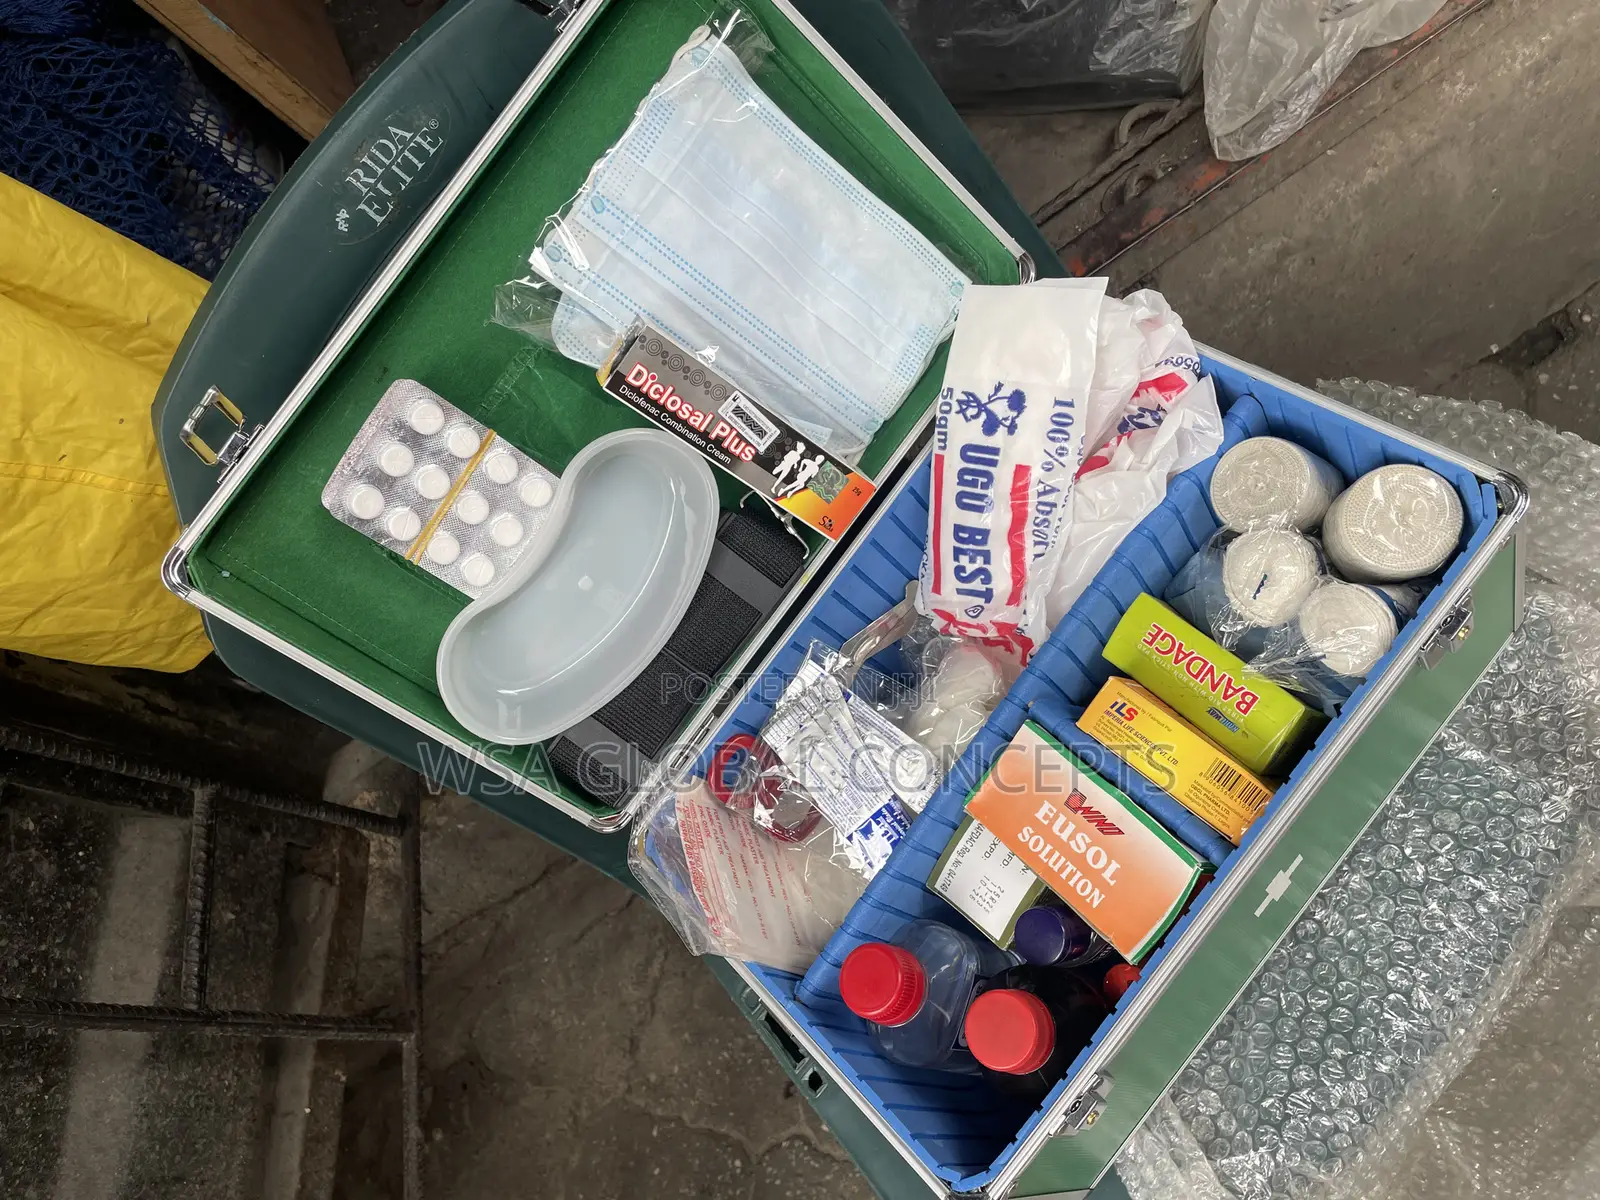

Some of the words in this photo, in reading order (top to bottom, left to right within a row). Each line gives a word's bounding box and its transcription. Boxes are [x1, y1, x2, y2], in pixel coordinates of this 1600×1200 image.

[345, 126, 414, 196] RIDA
[618, 383, 661, 417] Diclofenac
[659, 411, 707, 448] Combination
[705, 442, 732, 465] Cream
[625, 361, 714, 433] Diclosal
[707, 418, 761, 465] Plus
[933, 386, 954, 451] 50gm
[1041, 395, 1075, 473] 100%
[951, 524, 1000, 604] BEST
[1136, 642, 1150, 655] PAD
[1141, 622, 1260, 717] BANDAGE
[1188, 680, 1207, 696] WITH
[1207, 694, 1221, 706] AID
[1102, 708, 1124, 726] IMPERIA
[1124, 723, 1134, 733] LIFE
[1132, 730, 1157, 750] SCIENCES
[1155, 746, 1168, 758] PVT.
[1221, 704, 1244, 723] FIRST
[1202, 792, 1221, 808] PHARMA
[1204, 776, 1228, 795] 906056
[1228, 794, 1254, 814] 841005
[711, 828, 724, 856] PLASTER
[746, 837, 759, 865] PLASTER
[1034, 800, 1123, 886] EUSOL
[725, 851, 740, 890] TREATMENT
[760, 860, 776, 899] TREATMENT
[1016, 825, 1105, 908] SOLUTION
